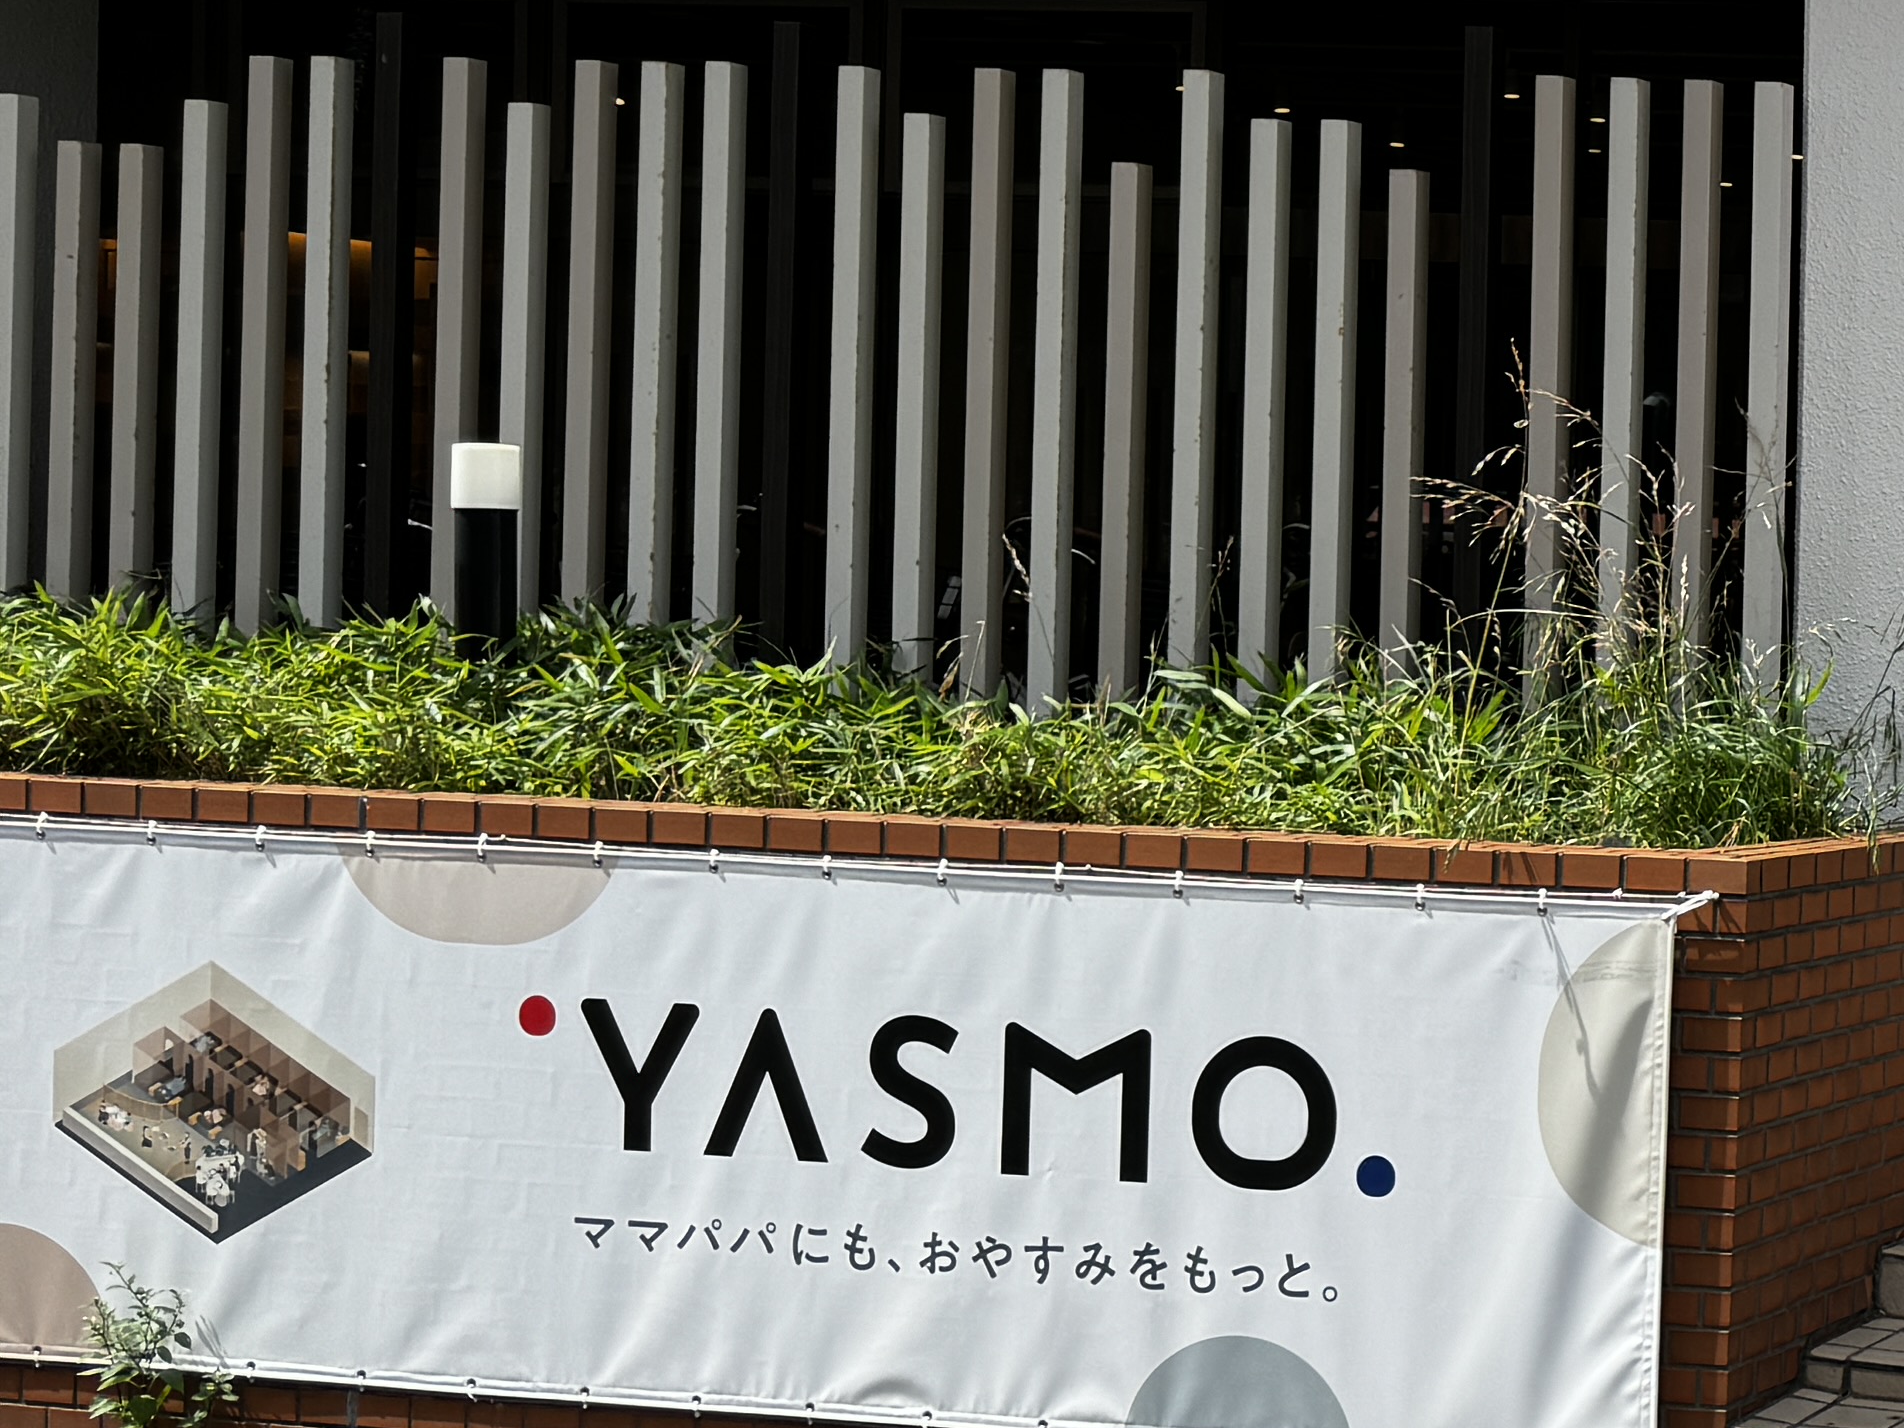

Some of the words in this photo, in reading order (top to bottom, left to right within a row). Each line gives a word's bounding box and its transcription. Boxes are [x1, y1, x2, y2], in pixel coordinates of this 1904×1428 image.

[573, 1215, 1339, 1304] ママパパにも、おやすみをもっと。
